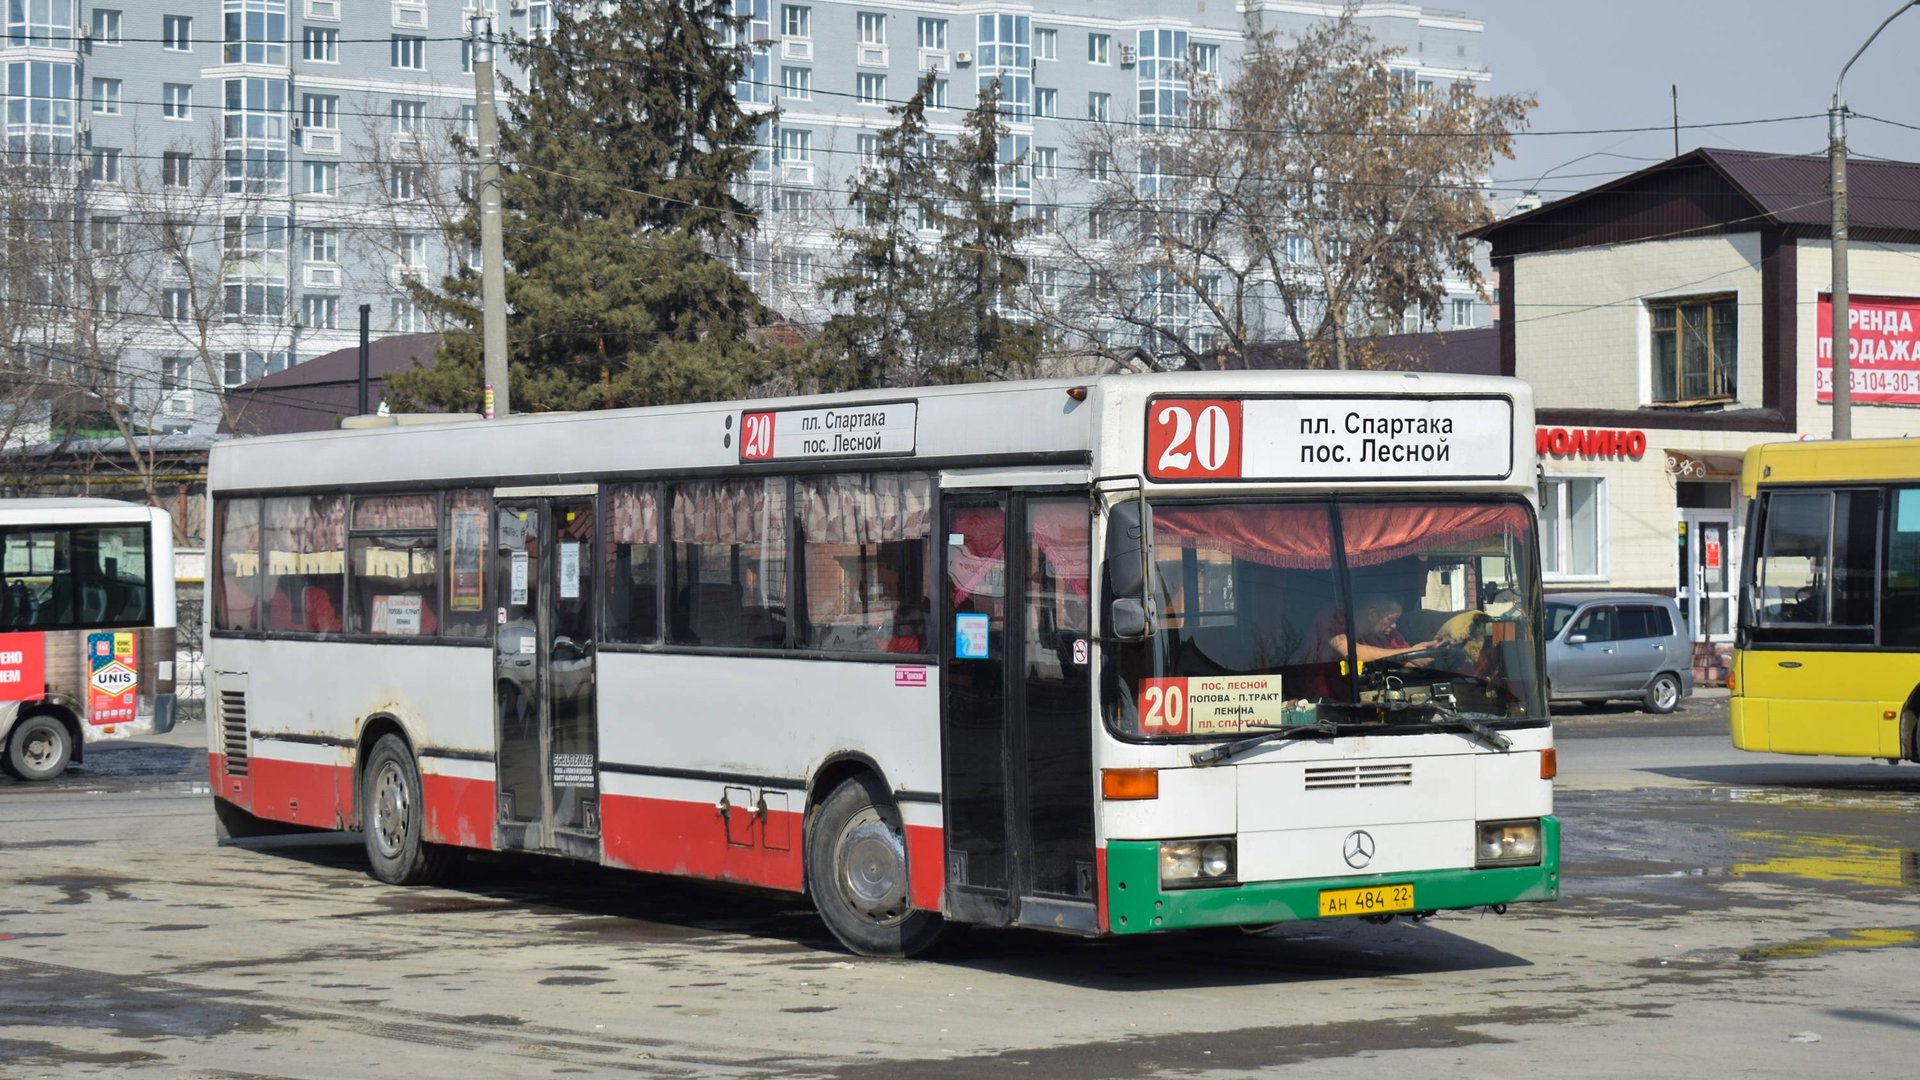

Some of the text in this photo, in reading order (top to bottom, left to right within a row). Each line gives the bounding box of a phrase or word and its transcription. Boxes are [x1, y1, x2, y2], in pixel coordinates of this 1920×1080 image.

[1848, 308, 1913, 335] РЕНДА
[1819, 337, 1920, 364] ПОДАЖА
[802, 410, 886, 432] пл. Спартака
[1300, 412, 1453, 439] пл. Спартака
[745, 414, 771, 457] 20
[803, 432, 882, 454] пос. Лесной
[1157, 405, 1231, 472] 20
[1301, 438, 1450, 463] пос. Лесной
[0, 651, 23, 664] ЕНО
[98, 673, 131, 684] UNIS
[1201, 680, 1268, 691] ПОС. ЛЕСНОЙ
[1144, 685, 1183, 727] 20
[1190, 694, 1230, 703] ПОПОВА
[1238, 692, 1279, 702] П.ТРАКТ
[1214, 706, 1255, 715] ЛЕНИНА
[1198, 718, 1269, 729] ПЛ. СПАРТАКА
[1328, 887, 1408, 912] АН 484 22
